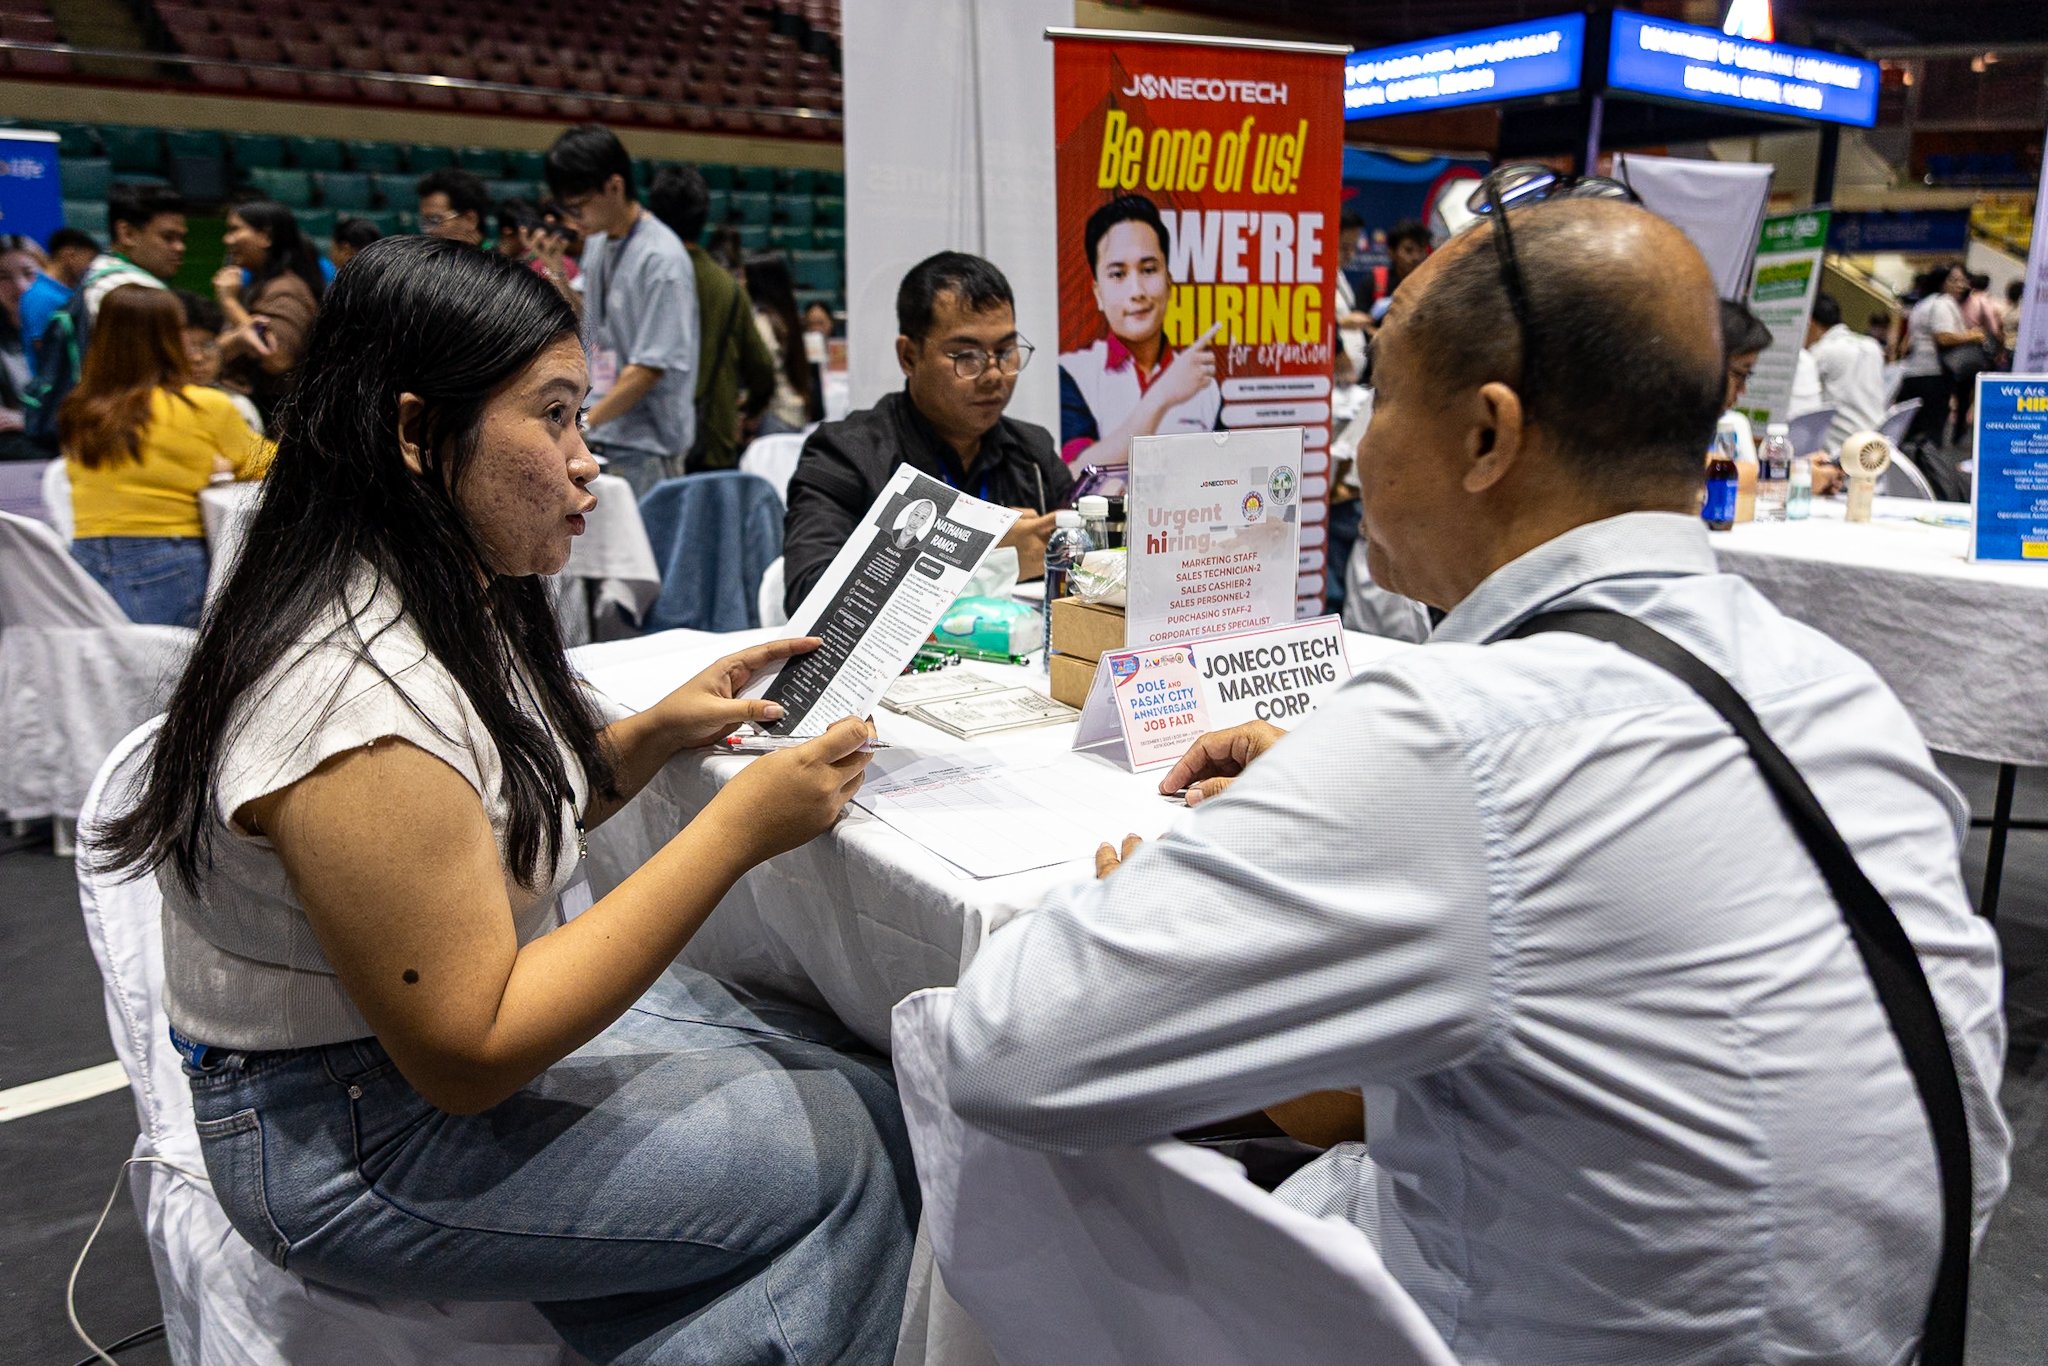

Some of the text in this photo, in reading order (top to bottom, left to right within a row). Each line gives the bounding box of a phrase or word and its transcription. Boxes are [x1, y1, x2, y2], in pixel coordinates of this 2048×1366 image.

[1097, 110, 1308, 194] Be one of us!
[1159, 208, 1325, 284] WE'RE
[1163, 283, 1323, 346] HIRING
[1227, 332, 1252, 376] for
[2001, 385, 2046, 397] We Are
[1147, 502, 1222, 530] Urgent
[933, 518, 972, 542] NATHANIEL
[930, 534, 958, 553] RAMOS
[1146, 530, 1217, 555] hiring.
[1181, 551, 1258, 569] MARKETING STAFF
[1176, 563, 1261, 583] SALES TECHNICIAN-2
[1181, 578, 1252, 595] SALES CASHIER-2
[1169, 591, 1250, 609] SALES PERSONNEL-2
[1167, 605, 1252, 625] PURCHASING STAFF-2
[1149, 616, 1271, 642] CORPORATE SALES SPECIALIST
[1203, 636, 1340, 679] JONECO TECH
[1136, 679, 1182, 694] DOLE AND
[1218, 662, 1336, 703] MARKETING
[1130, 687, 1194, 709] PASAY CITY
[1254, 692, 1318, 721] CORP.
[1134, 700, 1198, 720] ANNIVERSARY
[1144, 713, 1195, 732] JOB FAIR
